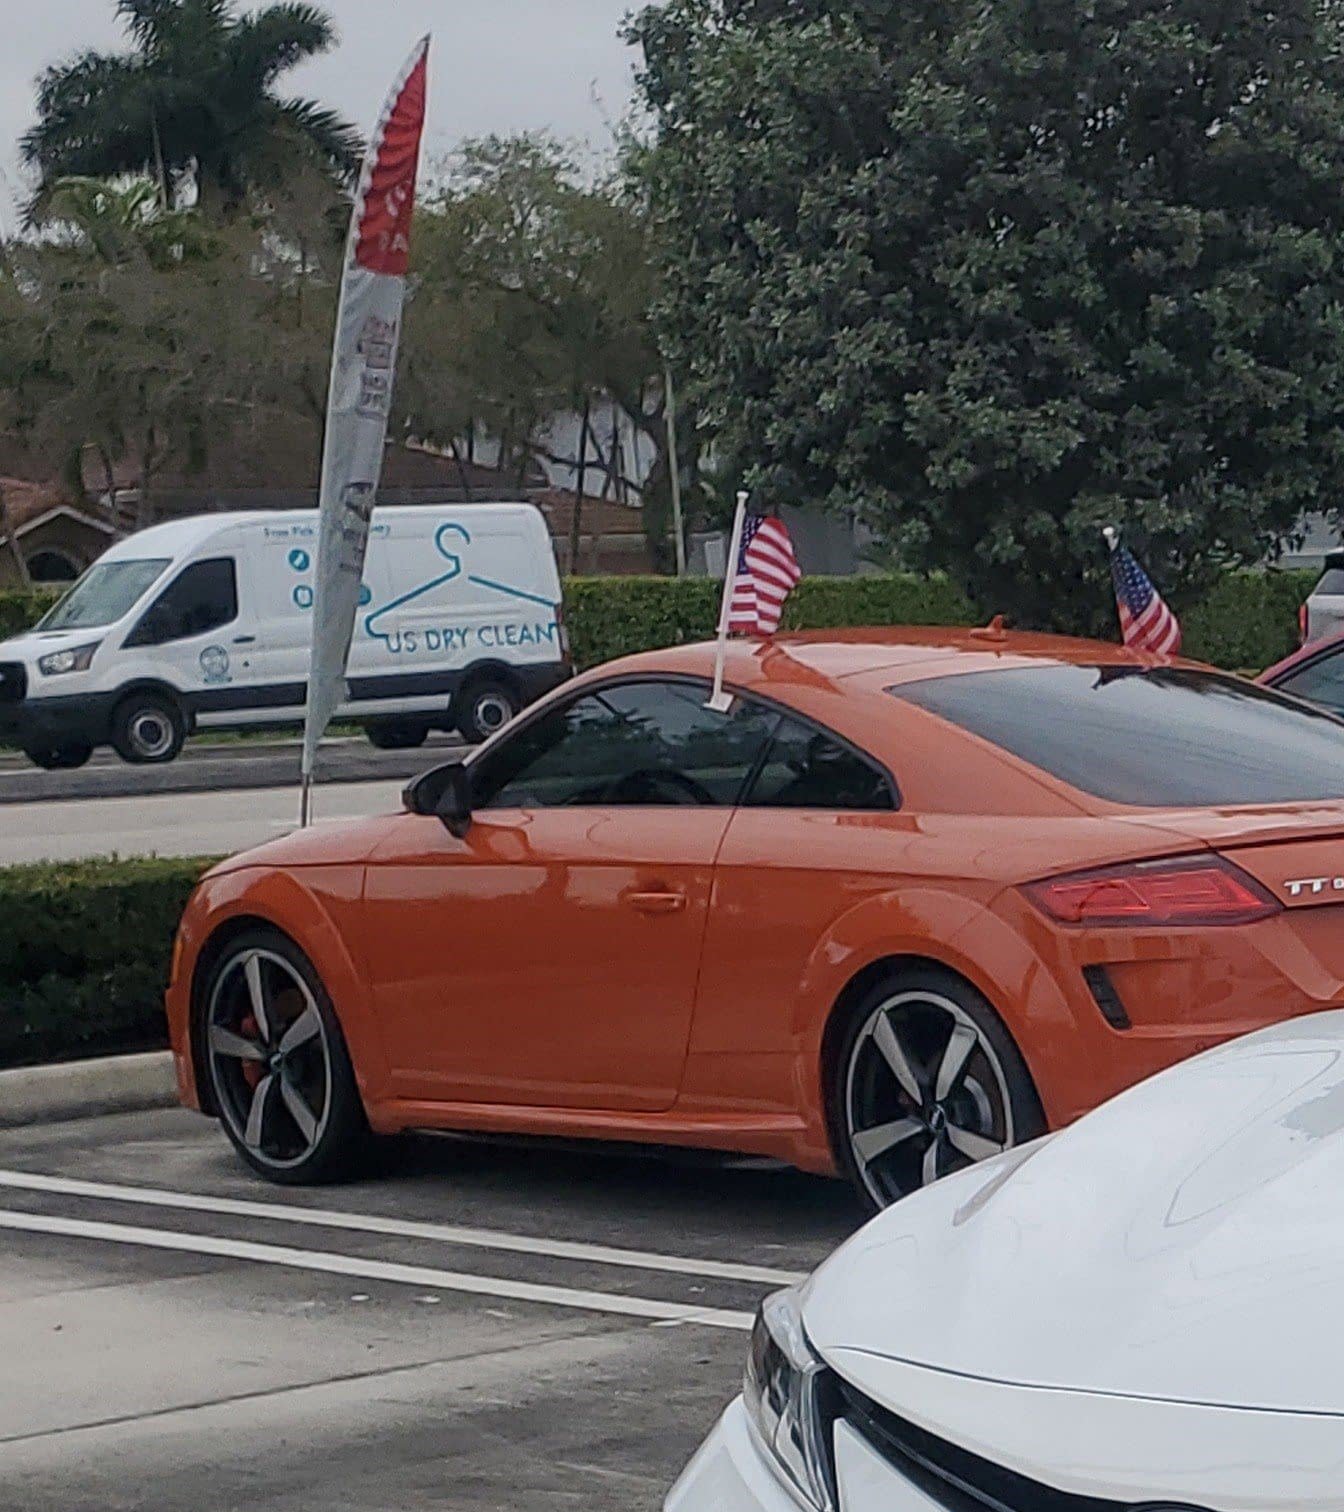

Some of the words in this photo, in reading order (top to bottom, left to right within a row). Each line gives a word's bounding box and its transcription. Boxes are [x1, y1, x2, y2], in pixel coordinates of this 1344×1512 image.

[385, 631, 418, 653] US
[425, 626, 469, 651] DRY
[477, 622, 557, 648] CLEAN
